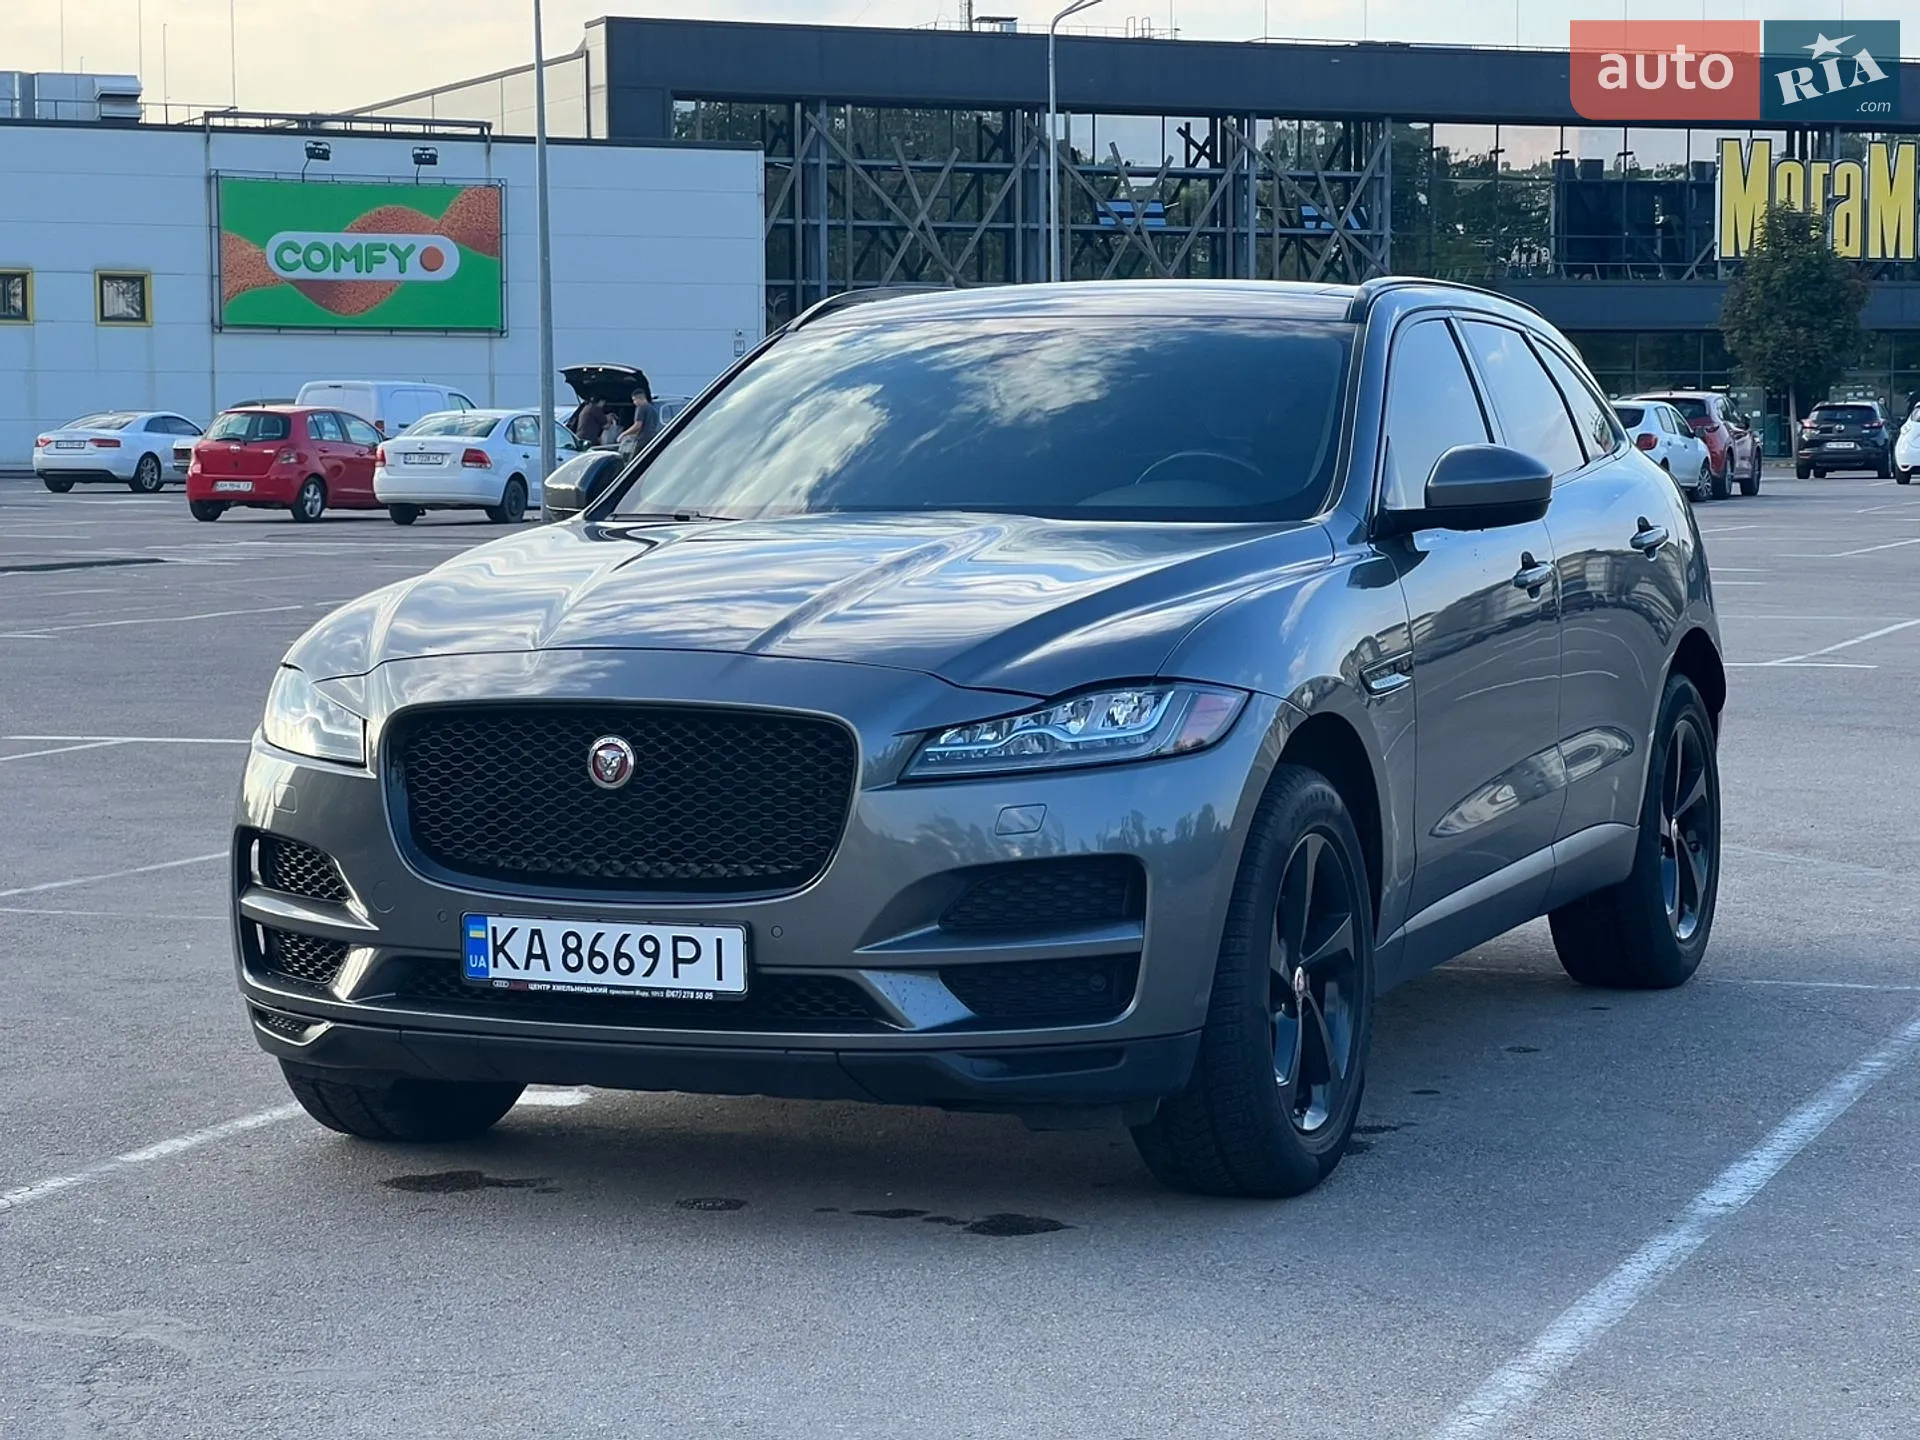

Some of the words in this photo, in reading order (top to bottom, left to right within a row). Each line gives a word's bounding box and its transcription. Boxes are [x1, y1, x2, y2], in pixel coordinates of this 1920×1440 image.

[274, 240, 416, 274] COMFY
[469, 956, 487, 968] UA
[528, 983, 551, 991] ЦЕНТР
